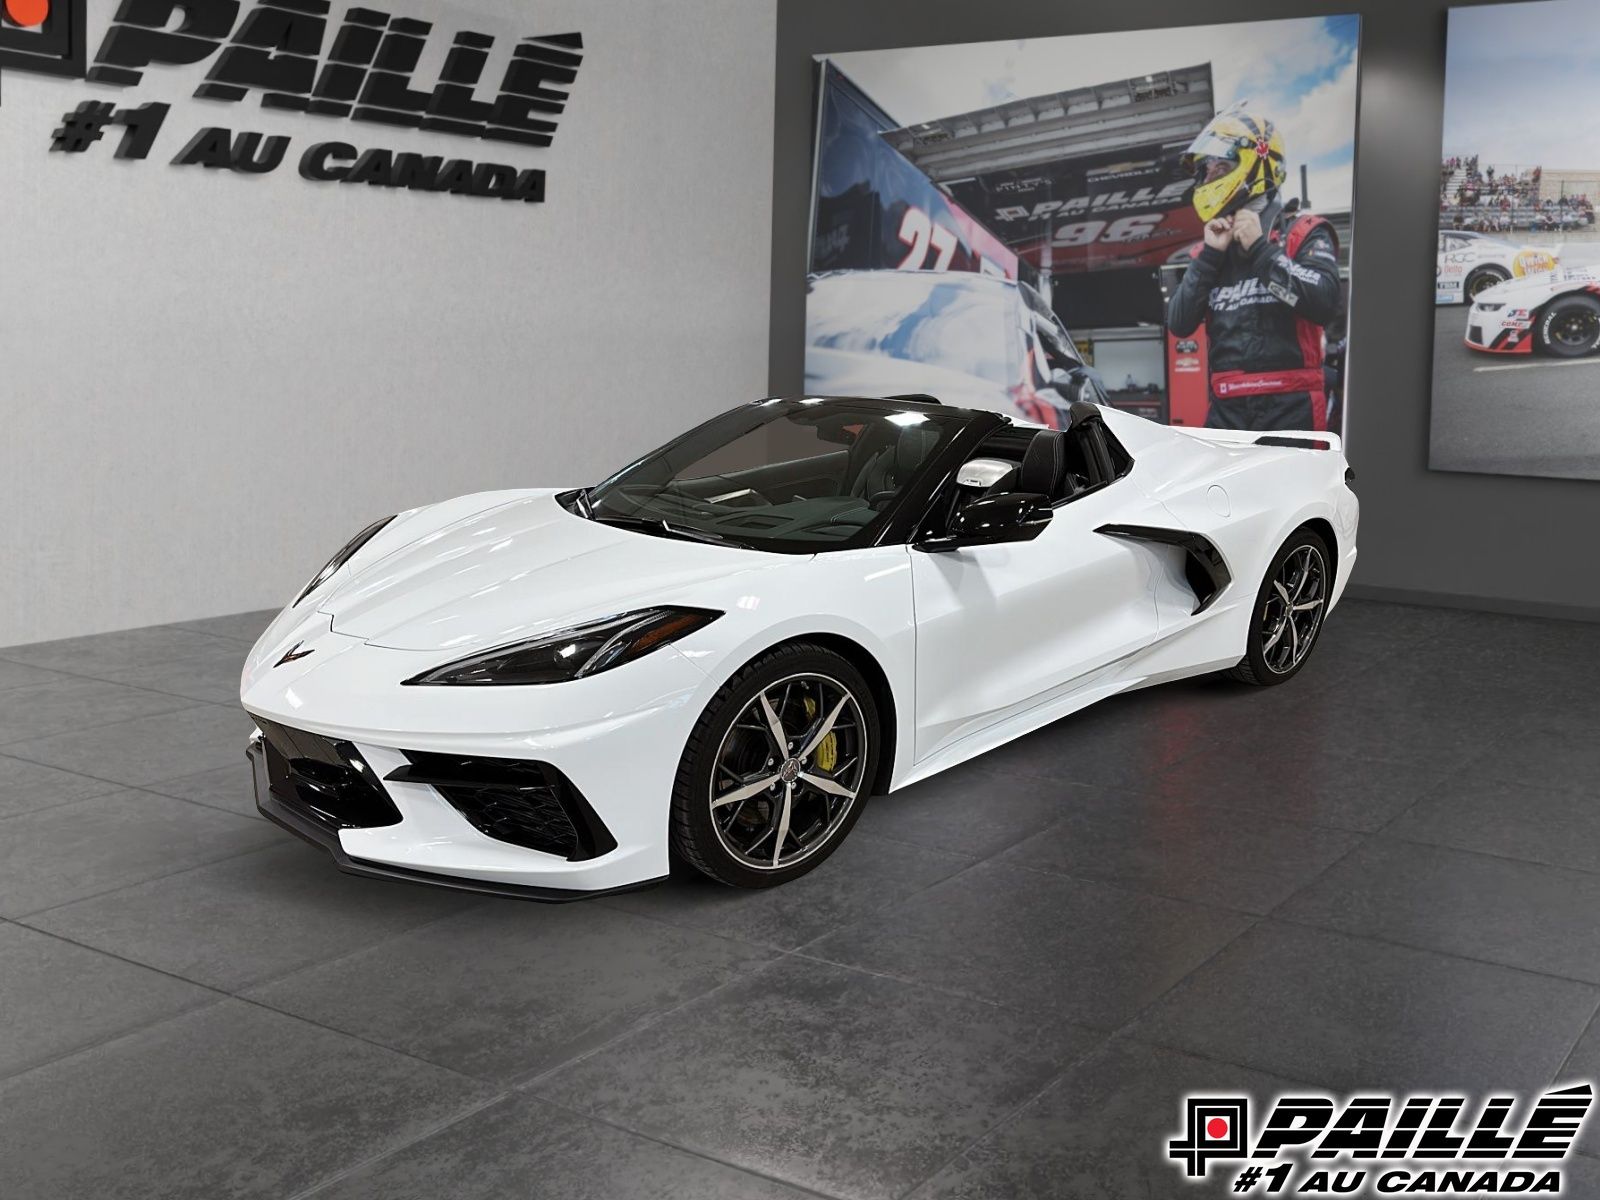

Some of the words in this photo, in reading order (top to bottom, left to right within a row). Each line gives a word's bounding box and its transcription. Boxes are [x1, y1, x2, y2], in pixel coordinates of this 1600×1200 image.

[49, 100, 171, 160] #1
[170, 127, 292, 173] AU
[298, 142, 546, 203] CANADA
[1056, 207, 1085, 218] AU
[1091, 197, 1182, 214] CANADA
[1050, 213, 1164, 247] 96
